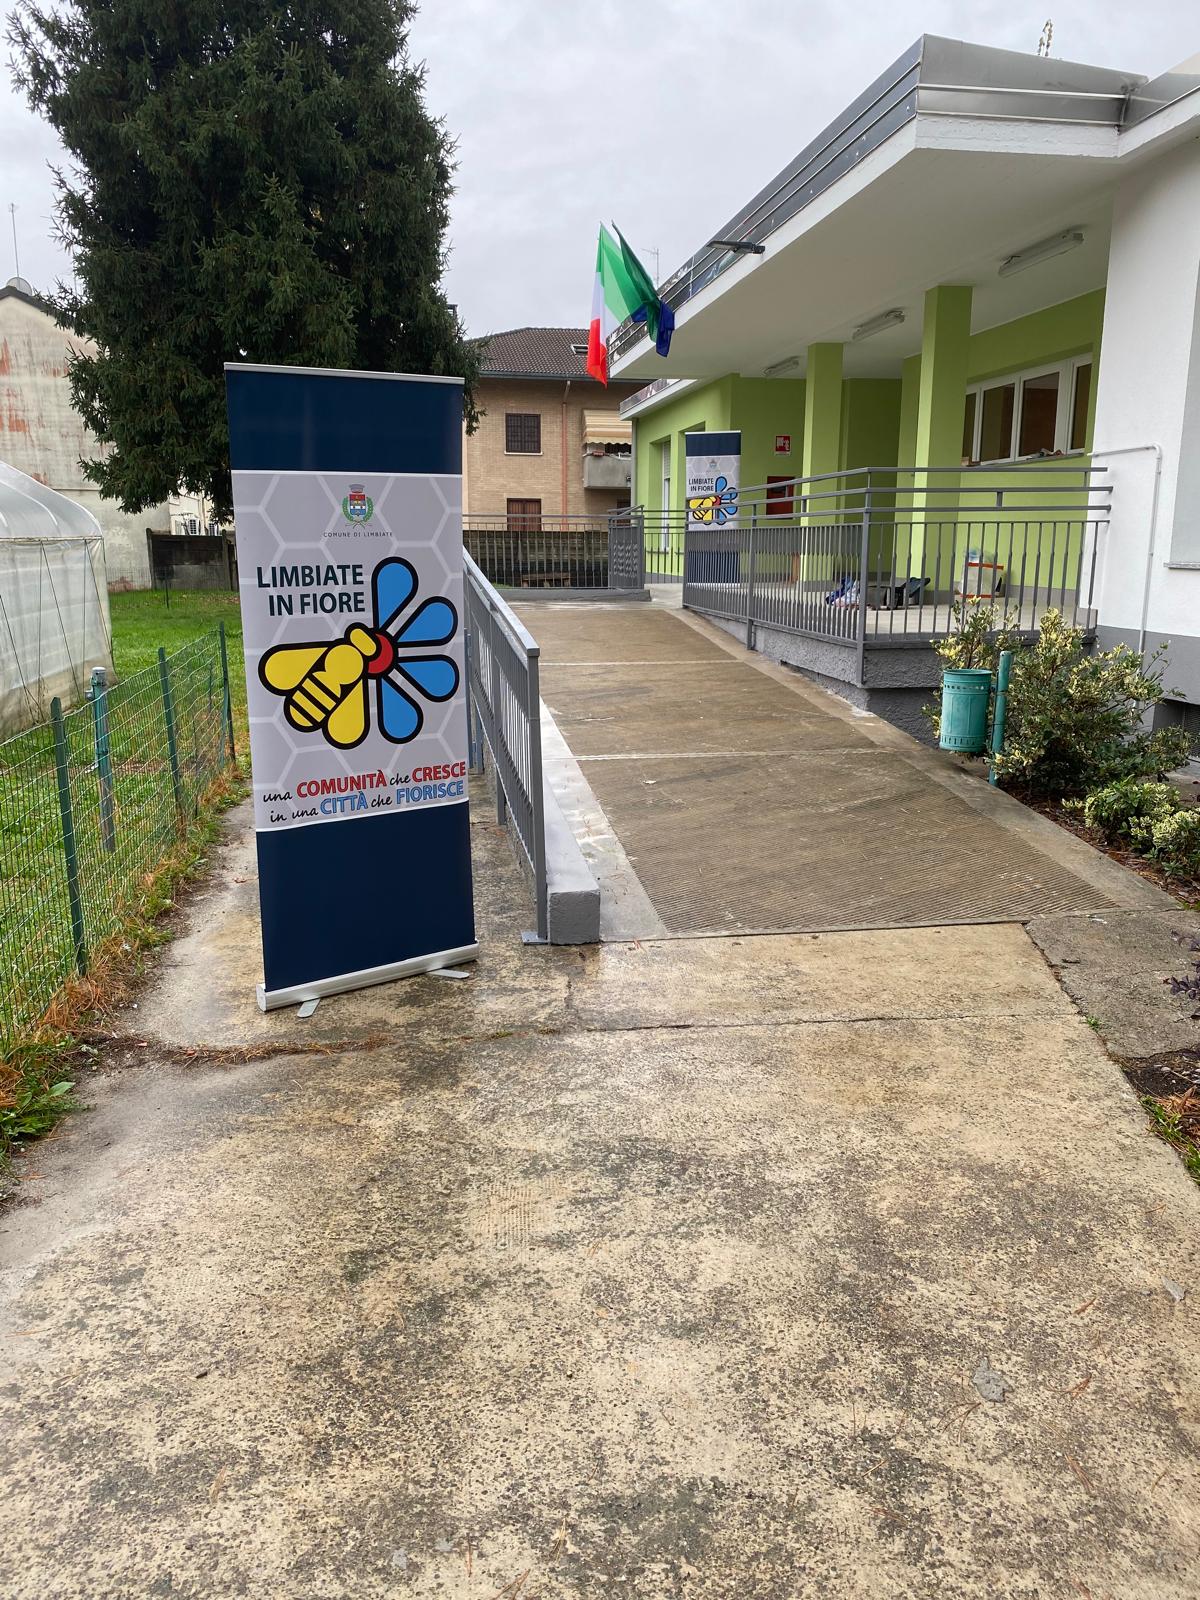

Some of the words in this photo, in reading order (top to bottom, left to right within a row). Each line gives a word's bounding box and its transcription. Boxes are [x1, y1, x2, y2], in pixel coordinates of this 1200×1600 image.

[256, 564, 364, 588] LIMBIATE
[268, 594, 294, 616] IN
[300, 592, 366, 615] FIORE
[263, 791, 292, 803] una
[296, 769, 387, 799] COMUNITÀ
[389, 773, 410, 786] che
[412, 761, 466, 783] CRESCE
[270, 811, 287, 823] in
[292, 808, 318, 819] una
[320, 791, 368, 815] CITTÀ
[370, 795, 392, 807] che
[396, 780, 464, 805] FIORISCE
